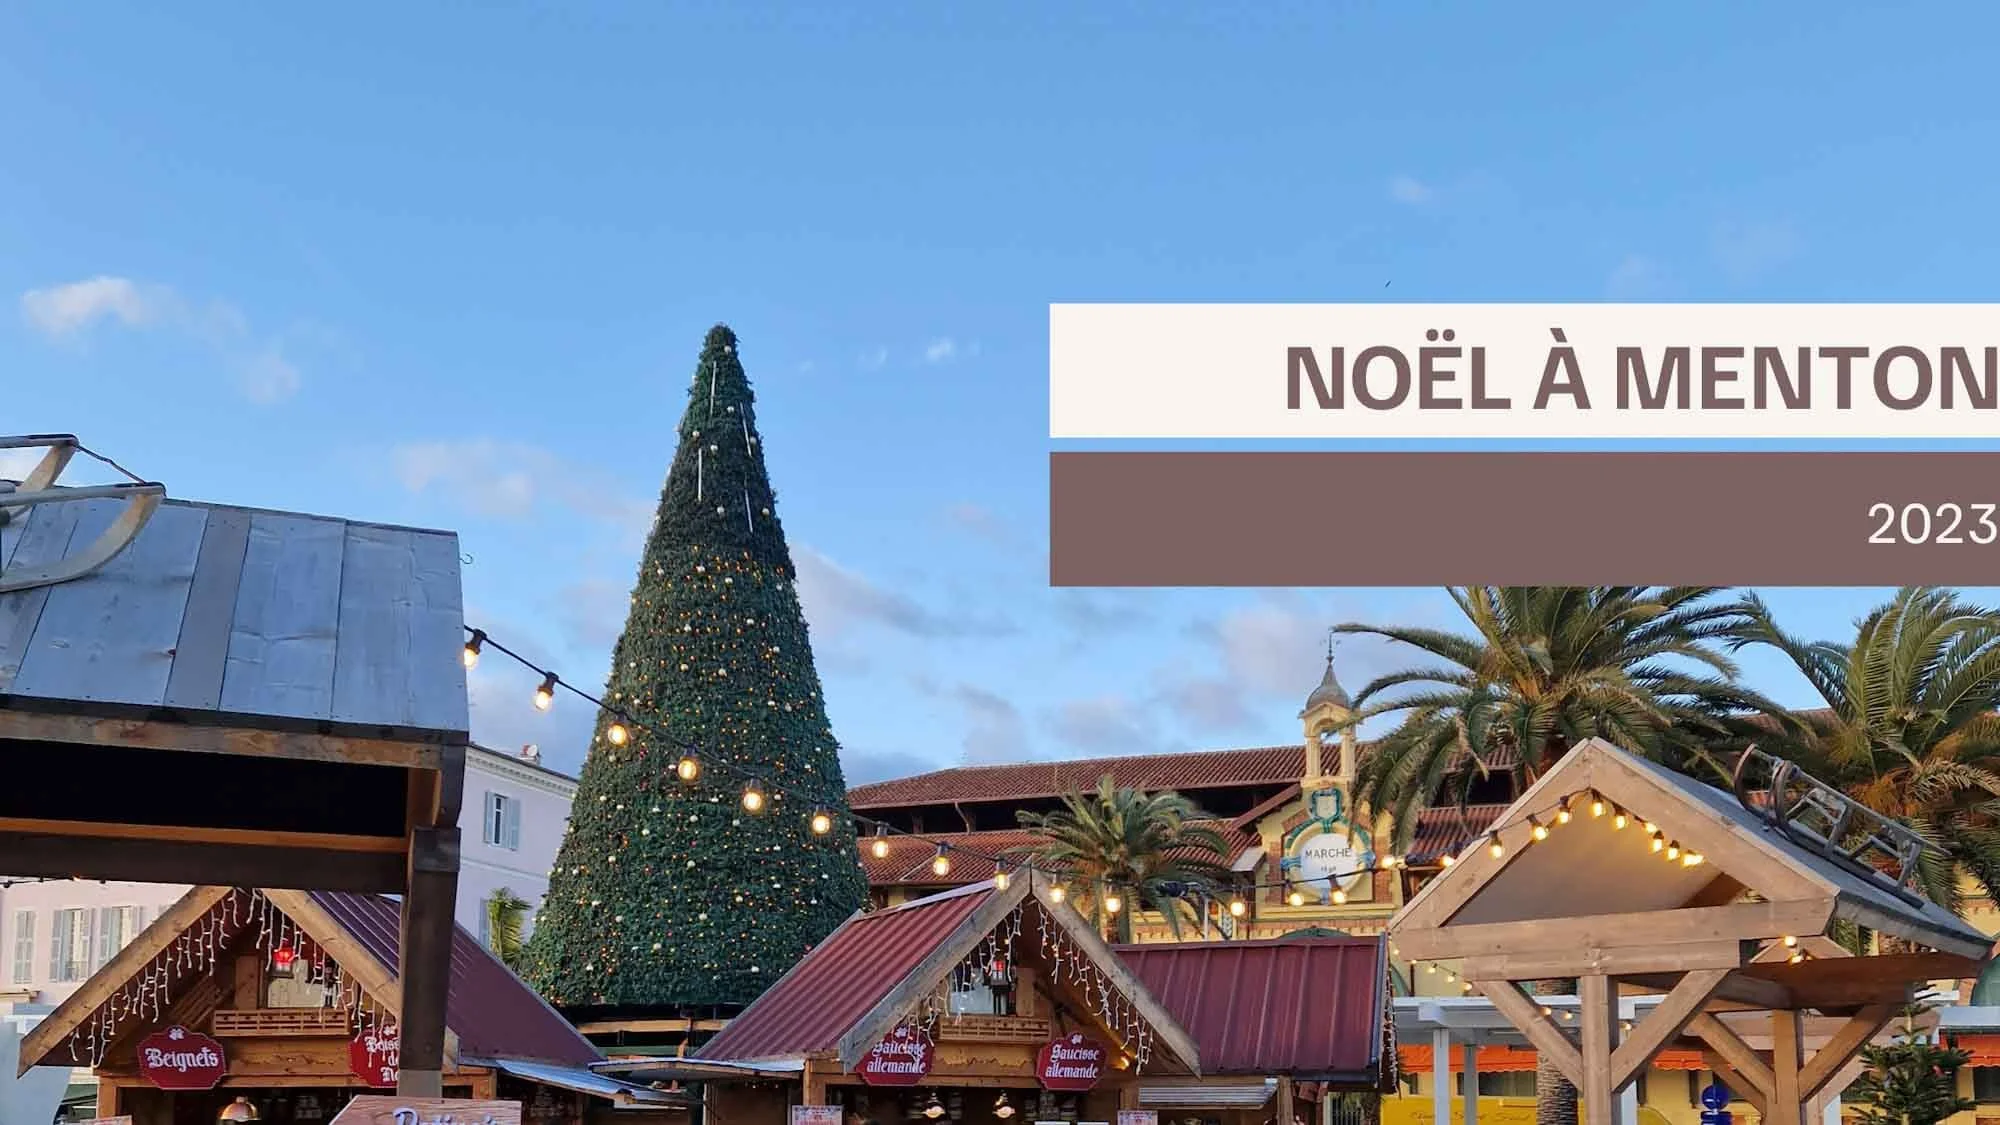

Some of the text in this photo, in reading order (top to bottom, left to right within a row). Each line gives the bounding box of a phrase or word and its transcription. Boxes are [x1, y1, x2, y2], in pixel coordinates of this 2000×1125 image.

[144, 1046, 219, 1073] Beignets
[1050, 1044, 1100, 1063] Saucisse
[866, 1057, 927, 1073] allemande
[1045, 1063, 1099, 1079] allemande
